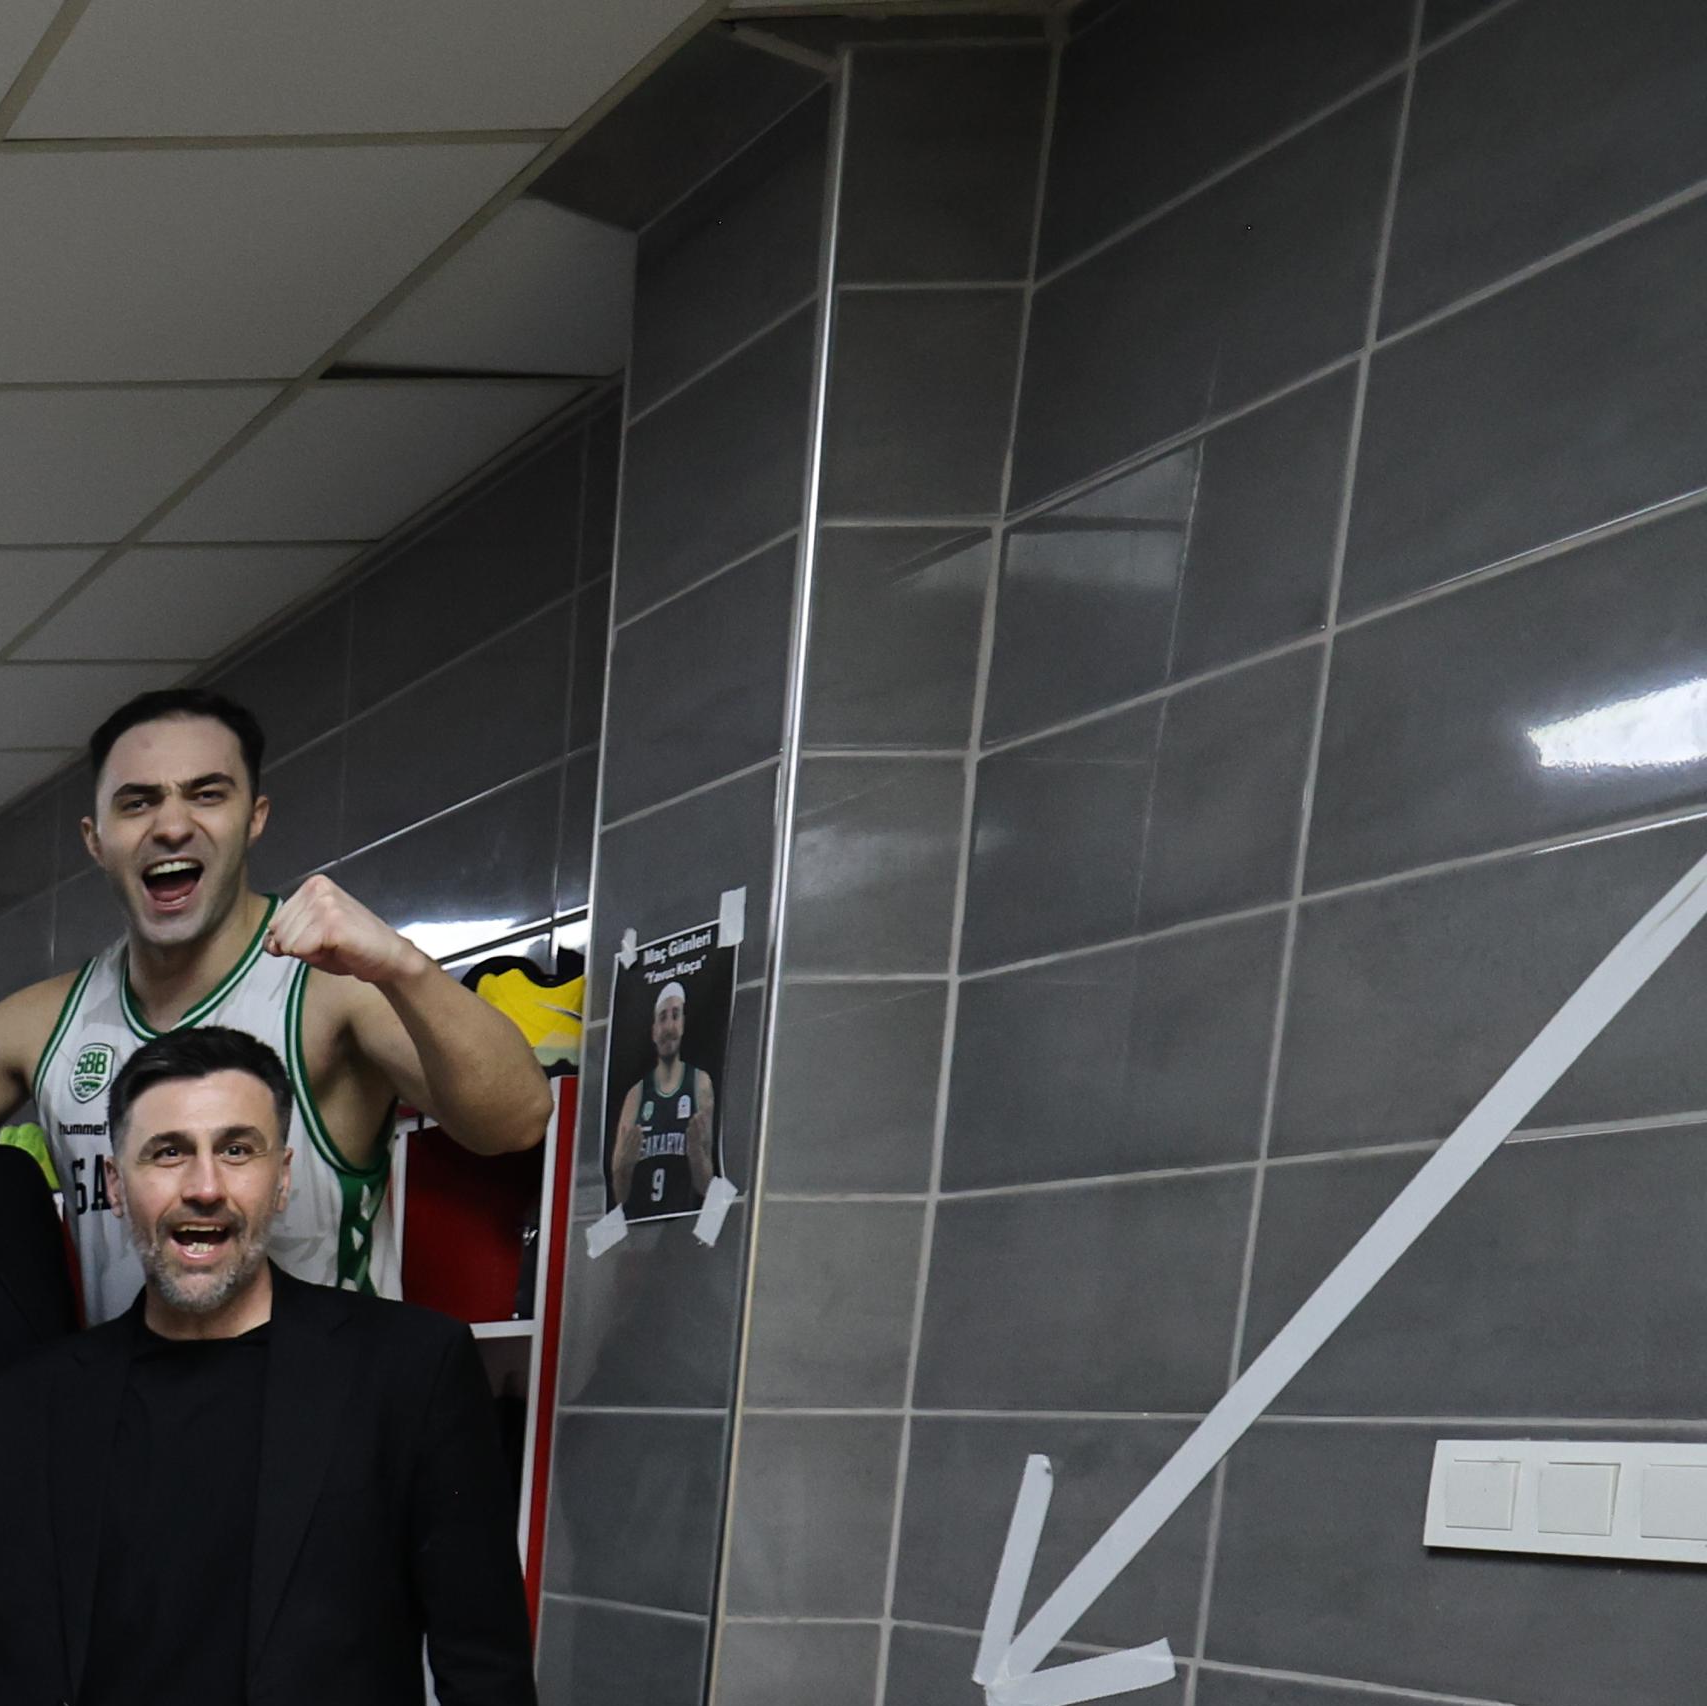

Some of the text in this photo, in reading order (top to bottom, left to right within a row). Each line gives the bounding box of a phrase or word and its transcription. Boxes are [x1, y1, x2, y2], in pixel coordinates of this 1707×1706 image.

[643, 929, 711, 966] Maç Günleri
[74, 1051, 109, 1076] SBB
[59, 1120, 108, 1136] hummel
[650, 1168, 666, 1202] 9
